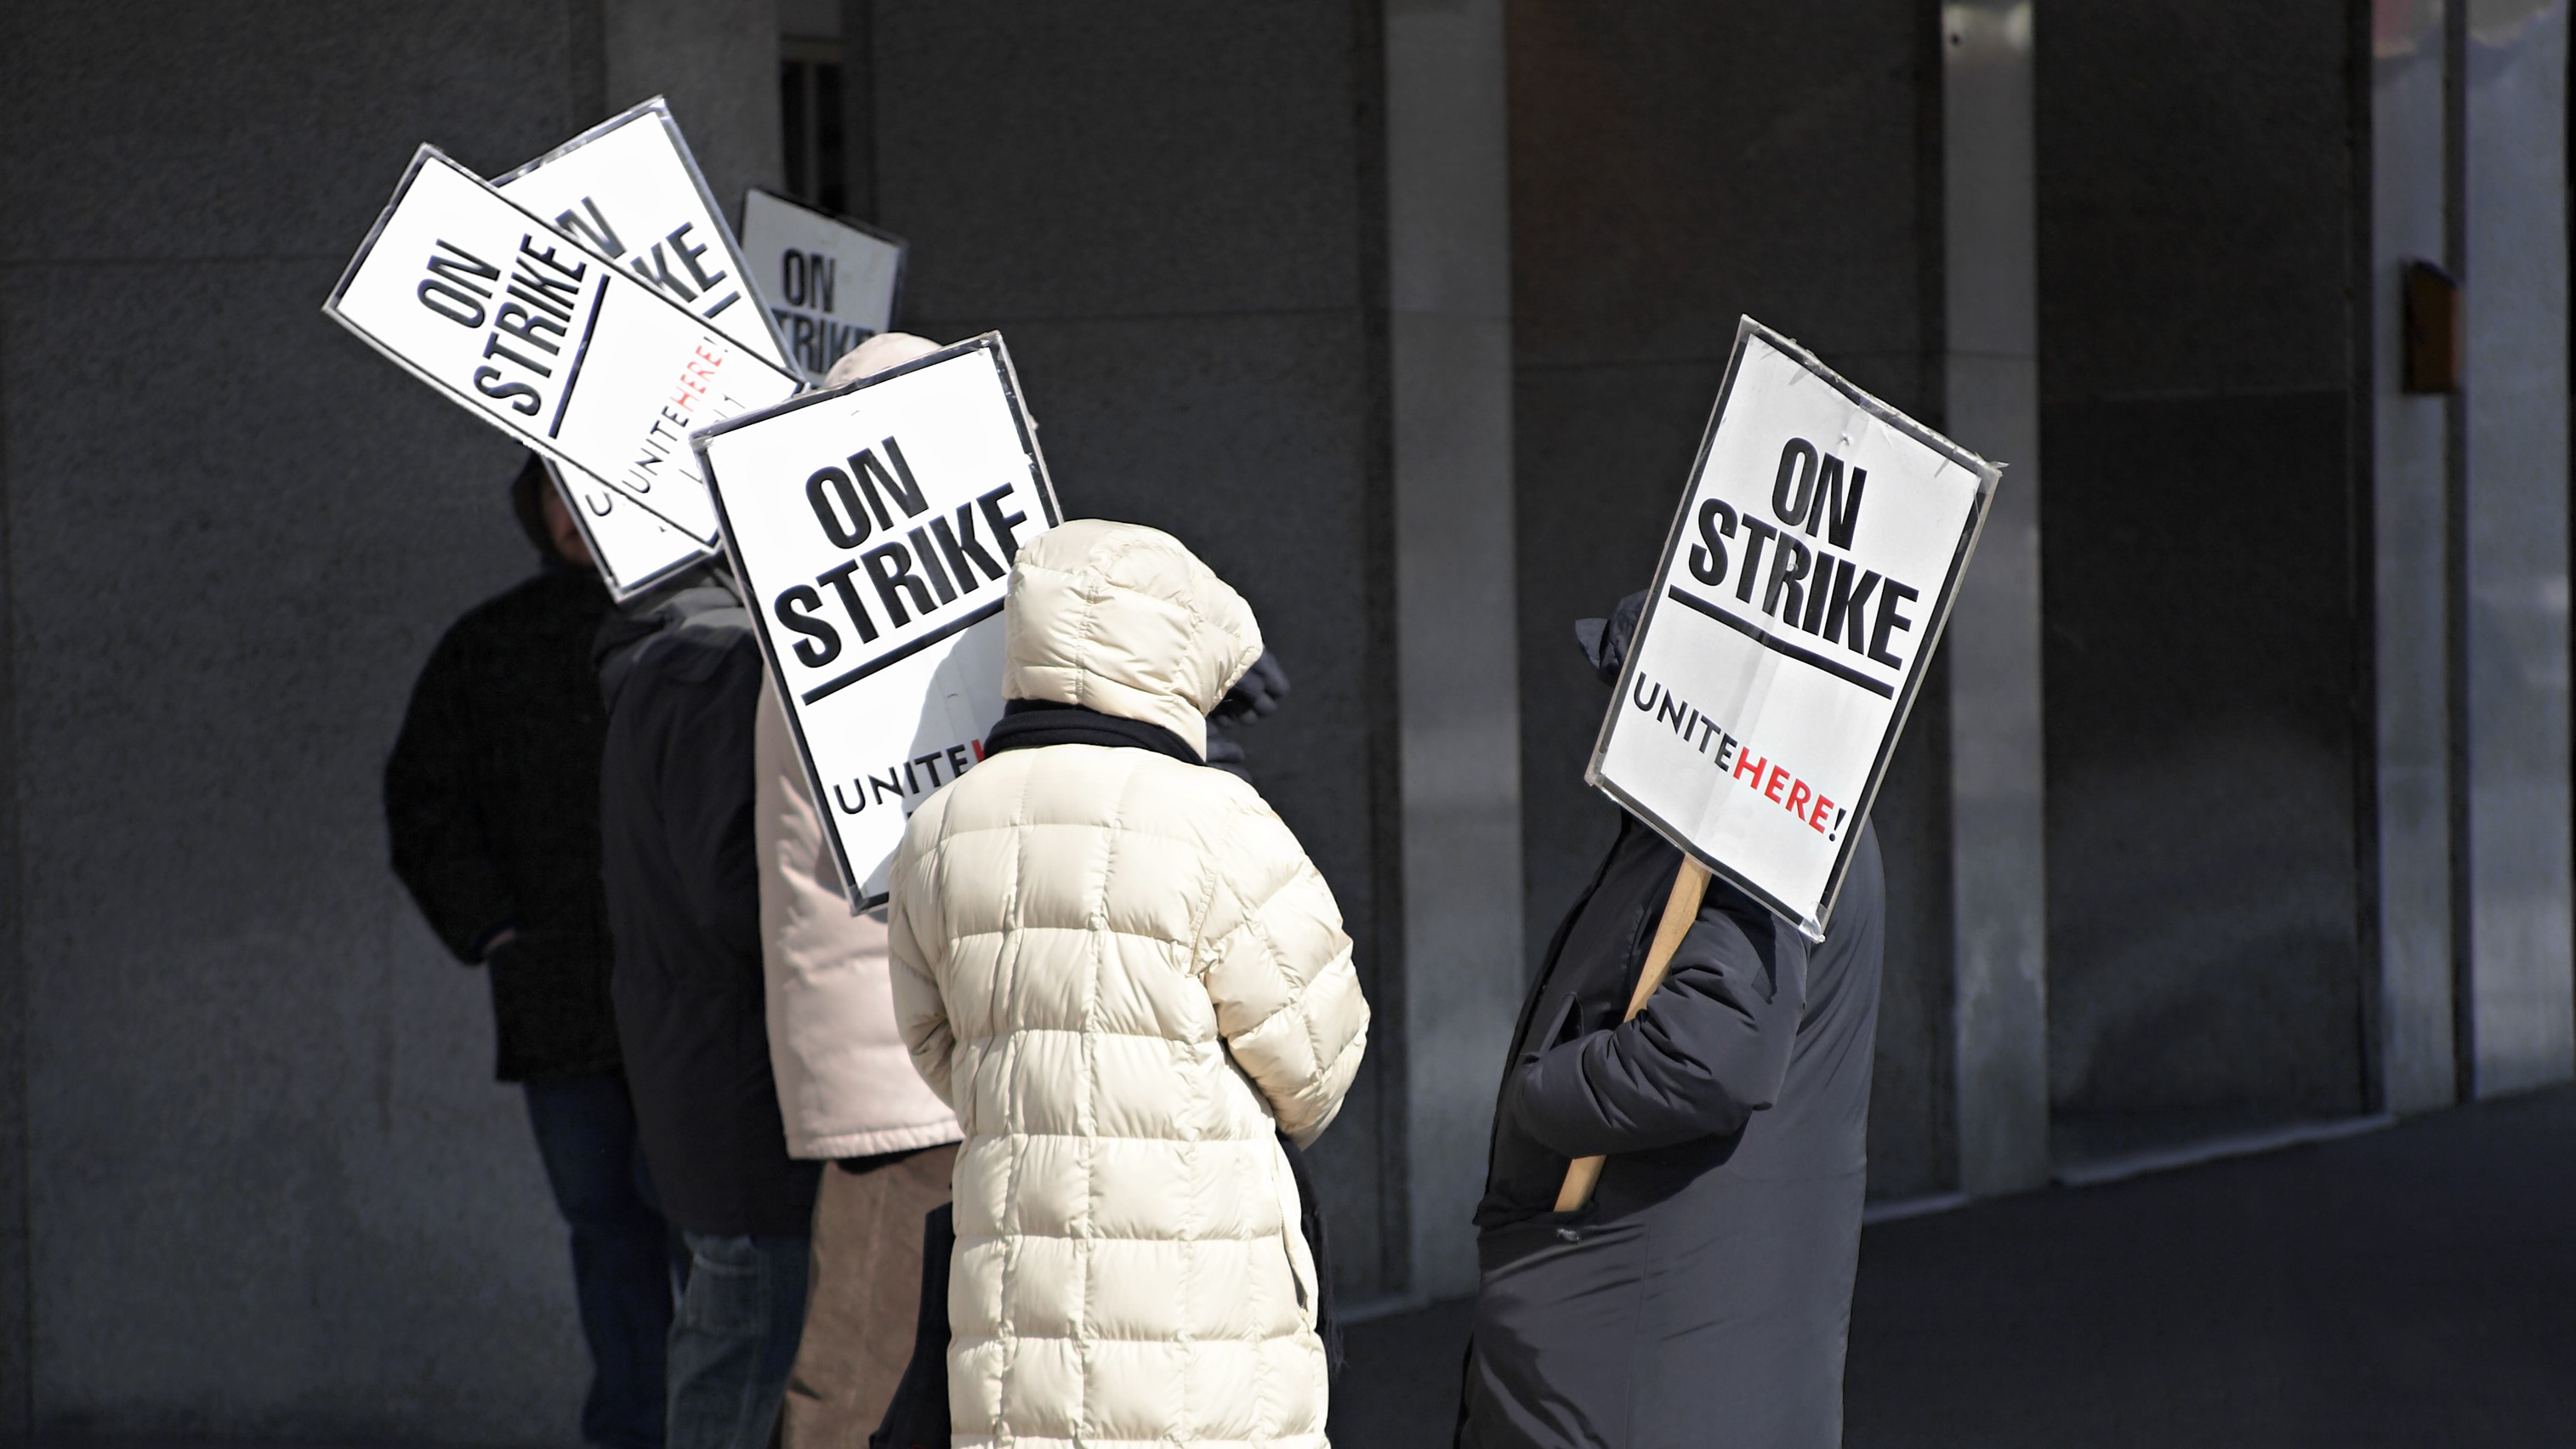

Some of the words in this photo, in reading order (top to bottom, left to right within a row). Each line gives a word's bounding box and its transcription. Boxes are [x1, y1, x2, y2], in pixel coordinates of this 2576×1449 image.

[417, 238, 501, 328] ON
[473, 232, 587, 416] STRIKE
[782, 247, 836, 314] ON
[805, 435, 930, 550] ON
[1771, 436, 1868, 552] ON
[773, 482, 1027, 668] STRIKE
[1688, 498, 1919, 671] STRIKE
